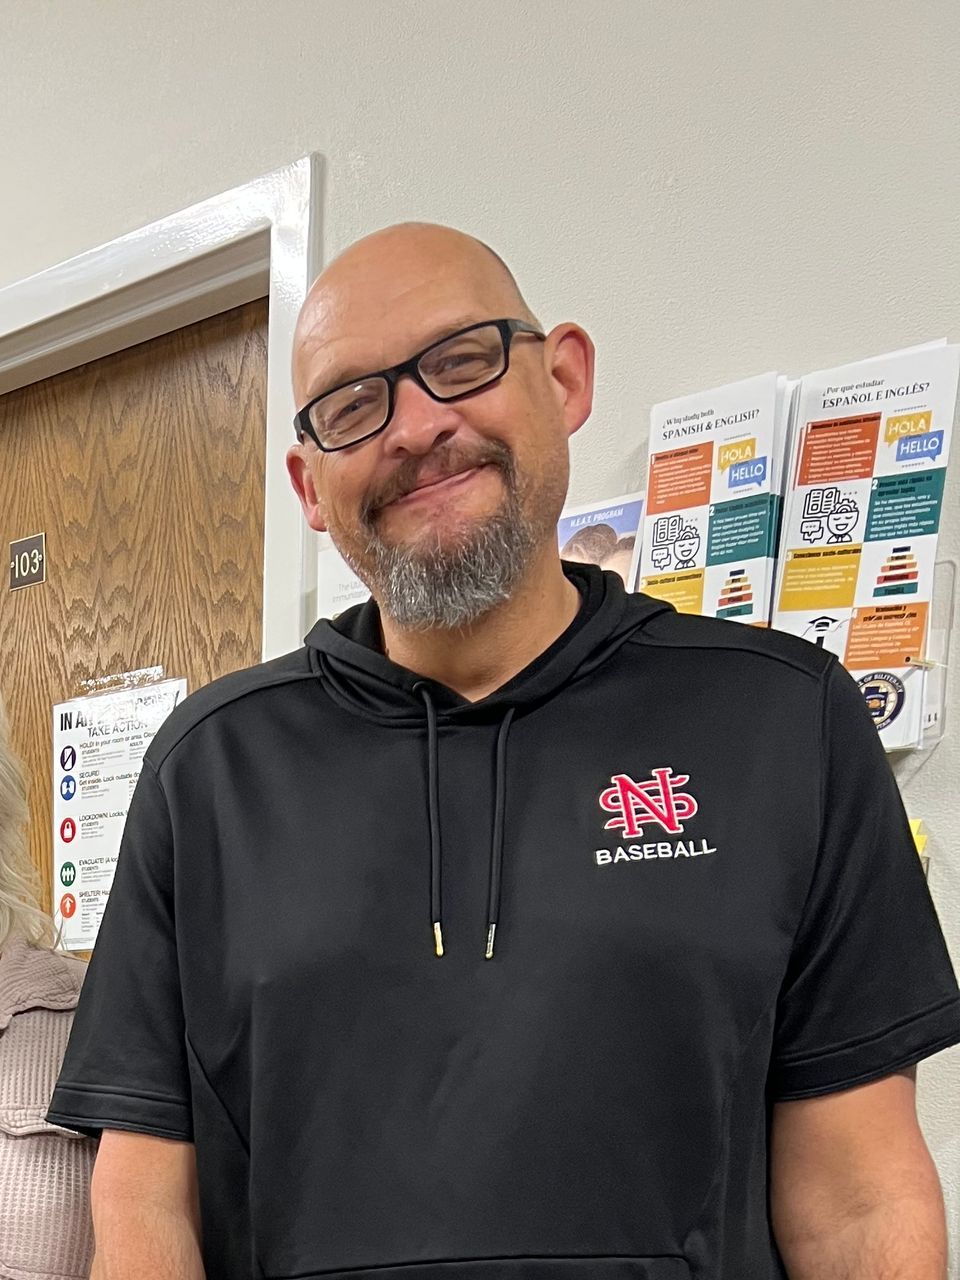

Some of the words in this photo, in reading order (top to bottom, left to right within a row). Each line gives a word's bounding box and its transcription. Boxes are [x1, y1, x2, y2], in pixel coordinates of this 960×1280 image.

[856, 379, 885, 390] estudiar
[822, 393, 874, 408] ESPAÑOL
[876, 391, 883, 400] E
[663, 422, 703, 440] SPANISH
[706, 422, 713, 430] &
[715, 409, 759, 428] ENGLISH?
[683, 413, 700, 423] study
[701, 409, 714, 417] both
[889, 419, 926, 435] HOLA
[720, 446, 752, 463] HOLA
[900, 438, 939, 455] HELLO
[731, 464, 764, 480] HELLO
[594, 508, 623, 521] PROGRAM
[15, 549, 40, 578] 103
[61, 712, 72, 731] IN
[88, 724, 110, 737] TAKE
[596, 839, 716, 865] BASEBALL
